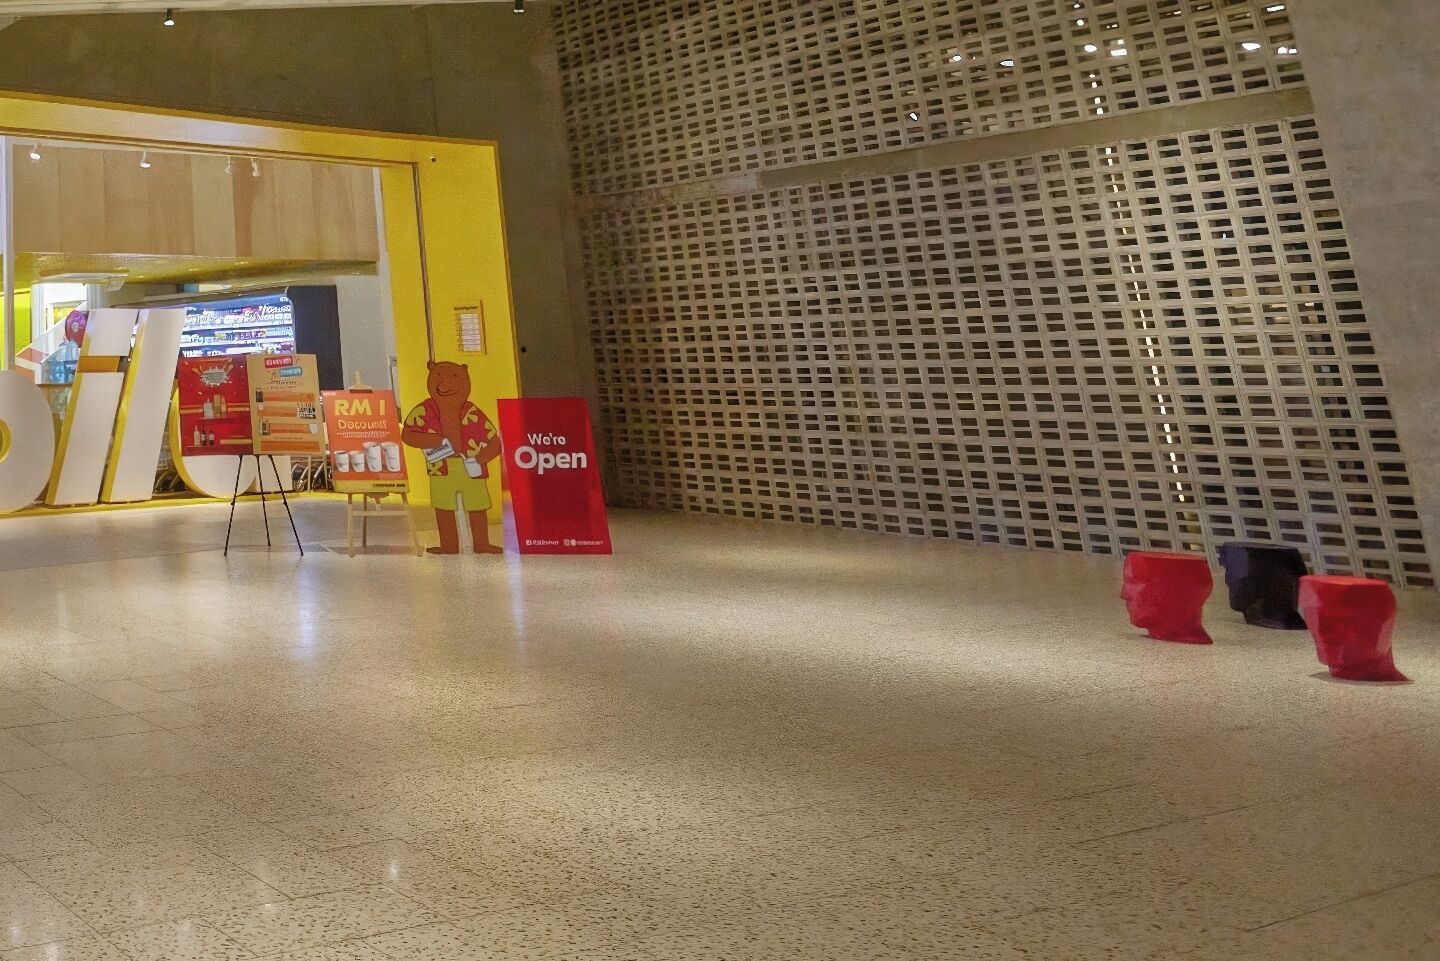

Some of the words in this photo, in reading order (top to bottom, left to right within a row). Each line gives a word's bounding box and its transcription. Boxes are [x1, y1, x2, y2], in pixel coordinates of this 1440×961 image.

[334, 398, 373, 416] RM
[527, 432, 567, 446] We're
[514, 445, 588, 475] Open
